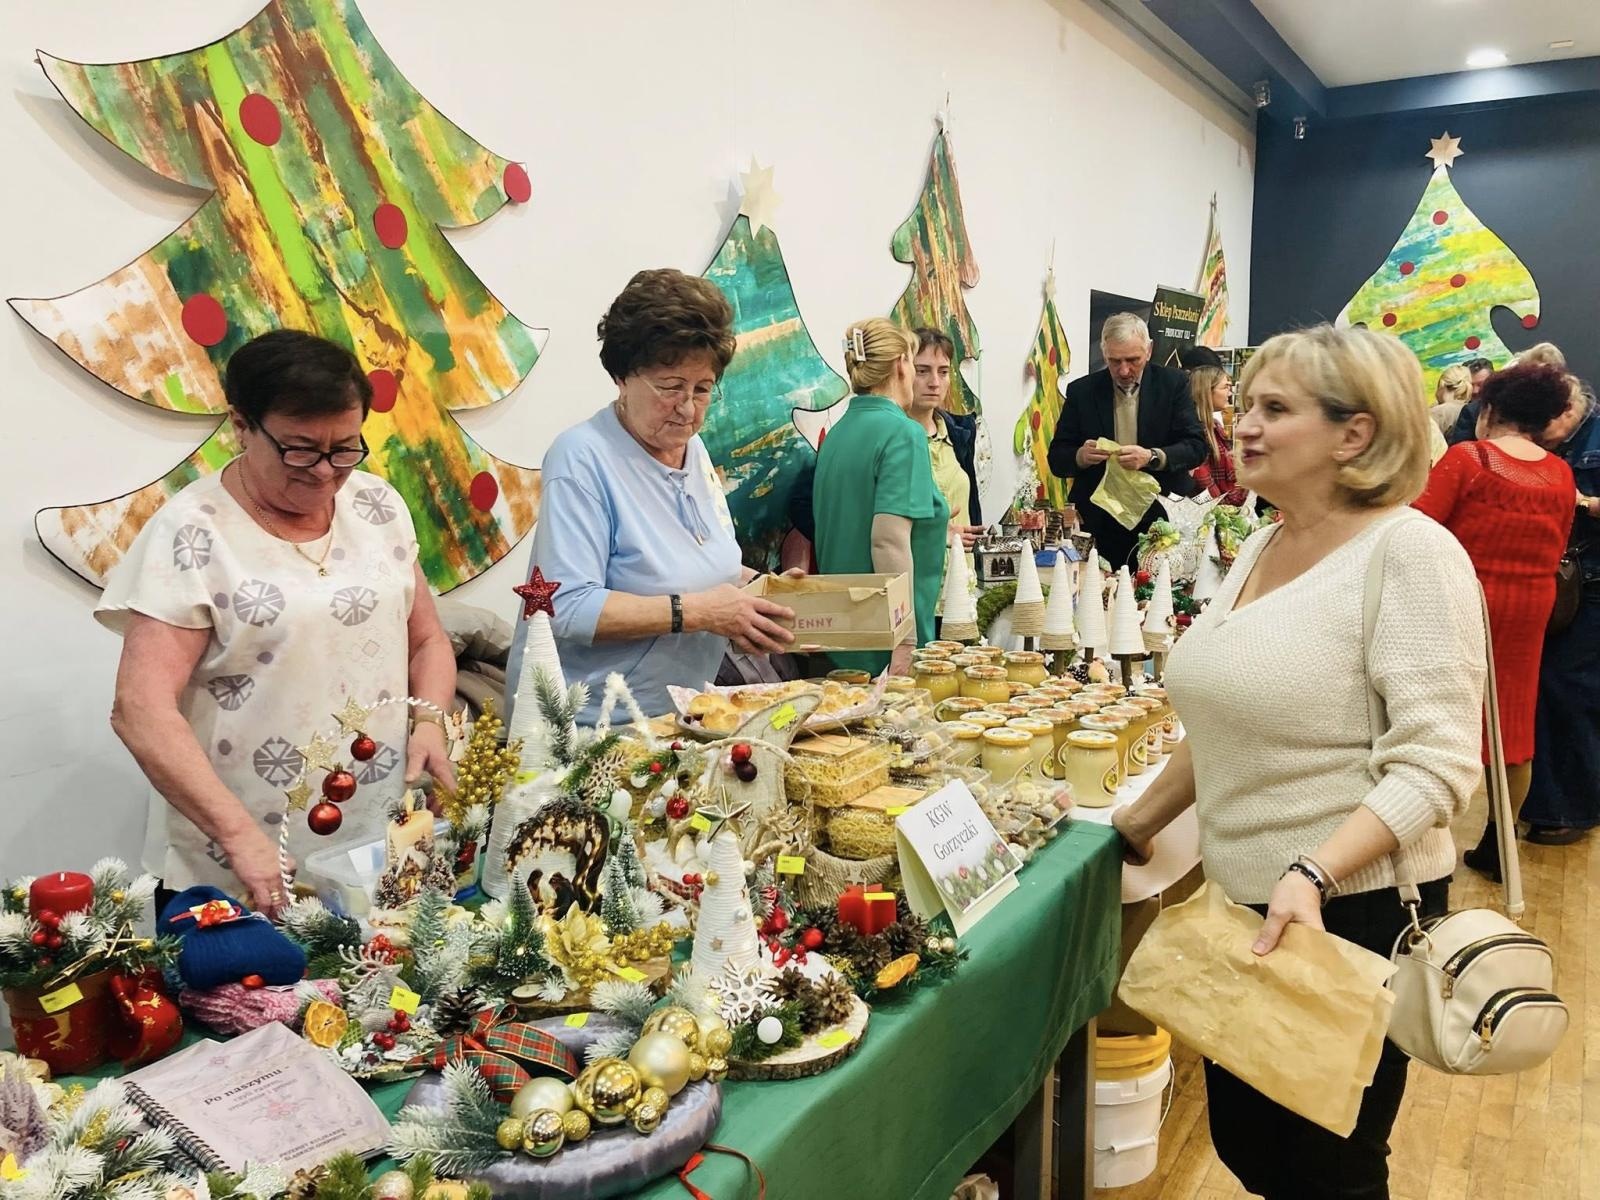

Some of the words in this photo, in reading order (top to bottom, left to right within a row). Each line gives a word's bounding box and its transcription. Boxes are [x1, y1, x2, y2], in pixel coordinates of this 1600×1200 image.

[1153, 301, 1172, 322] Sklep
[791, 617, 833, 629] JENNY
[925, 800, 953, 828] KGW
[933, 819, 979, 861] Gorzyczki
[203, 1095, 223, 1106] Po
[224, 1068, 283, 1097] naszymu
